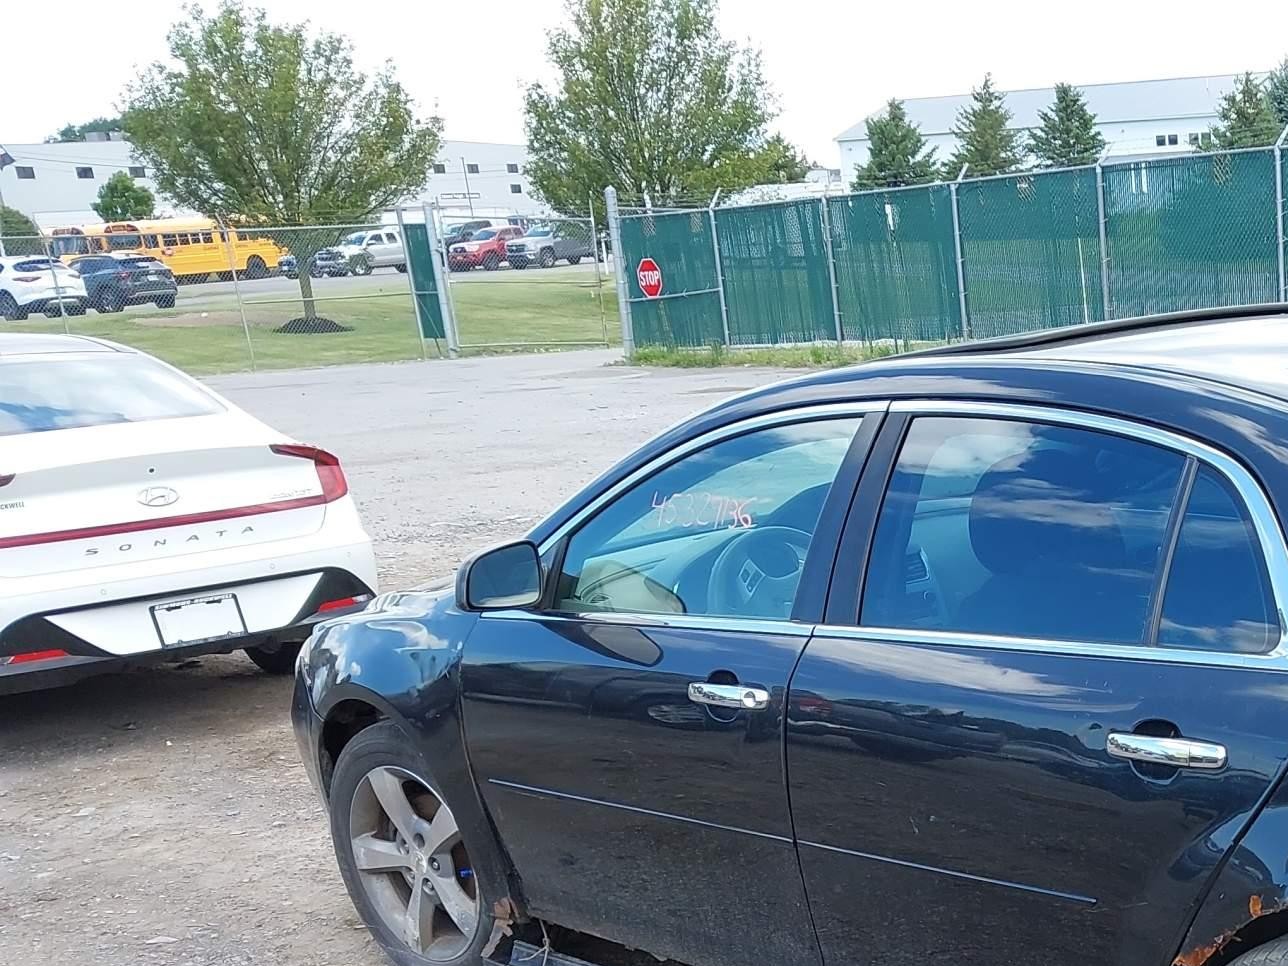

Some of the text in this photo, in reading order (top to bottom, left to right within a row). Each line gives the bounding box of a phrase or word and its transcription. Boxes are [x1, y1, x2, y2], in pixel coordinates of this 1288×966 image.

[640, 271, 659, 286] STOP
[0, 501, 24, 510] CKWELL
[84, 526, 254, 556] SONATA
